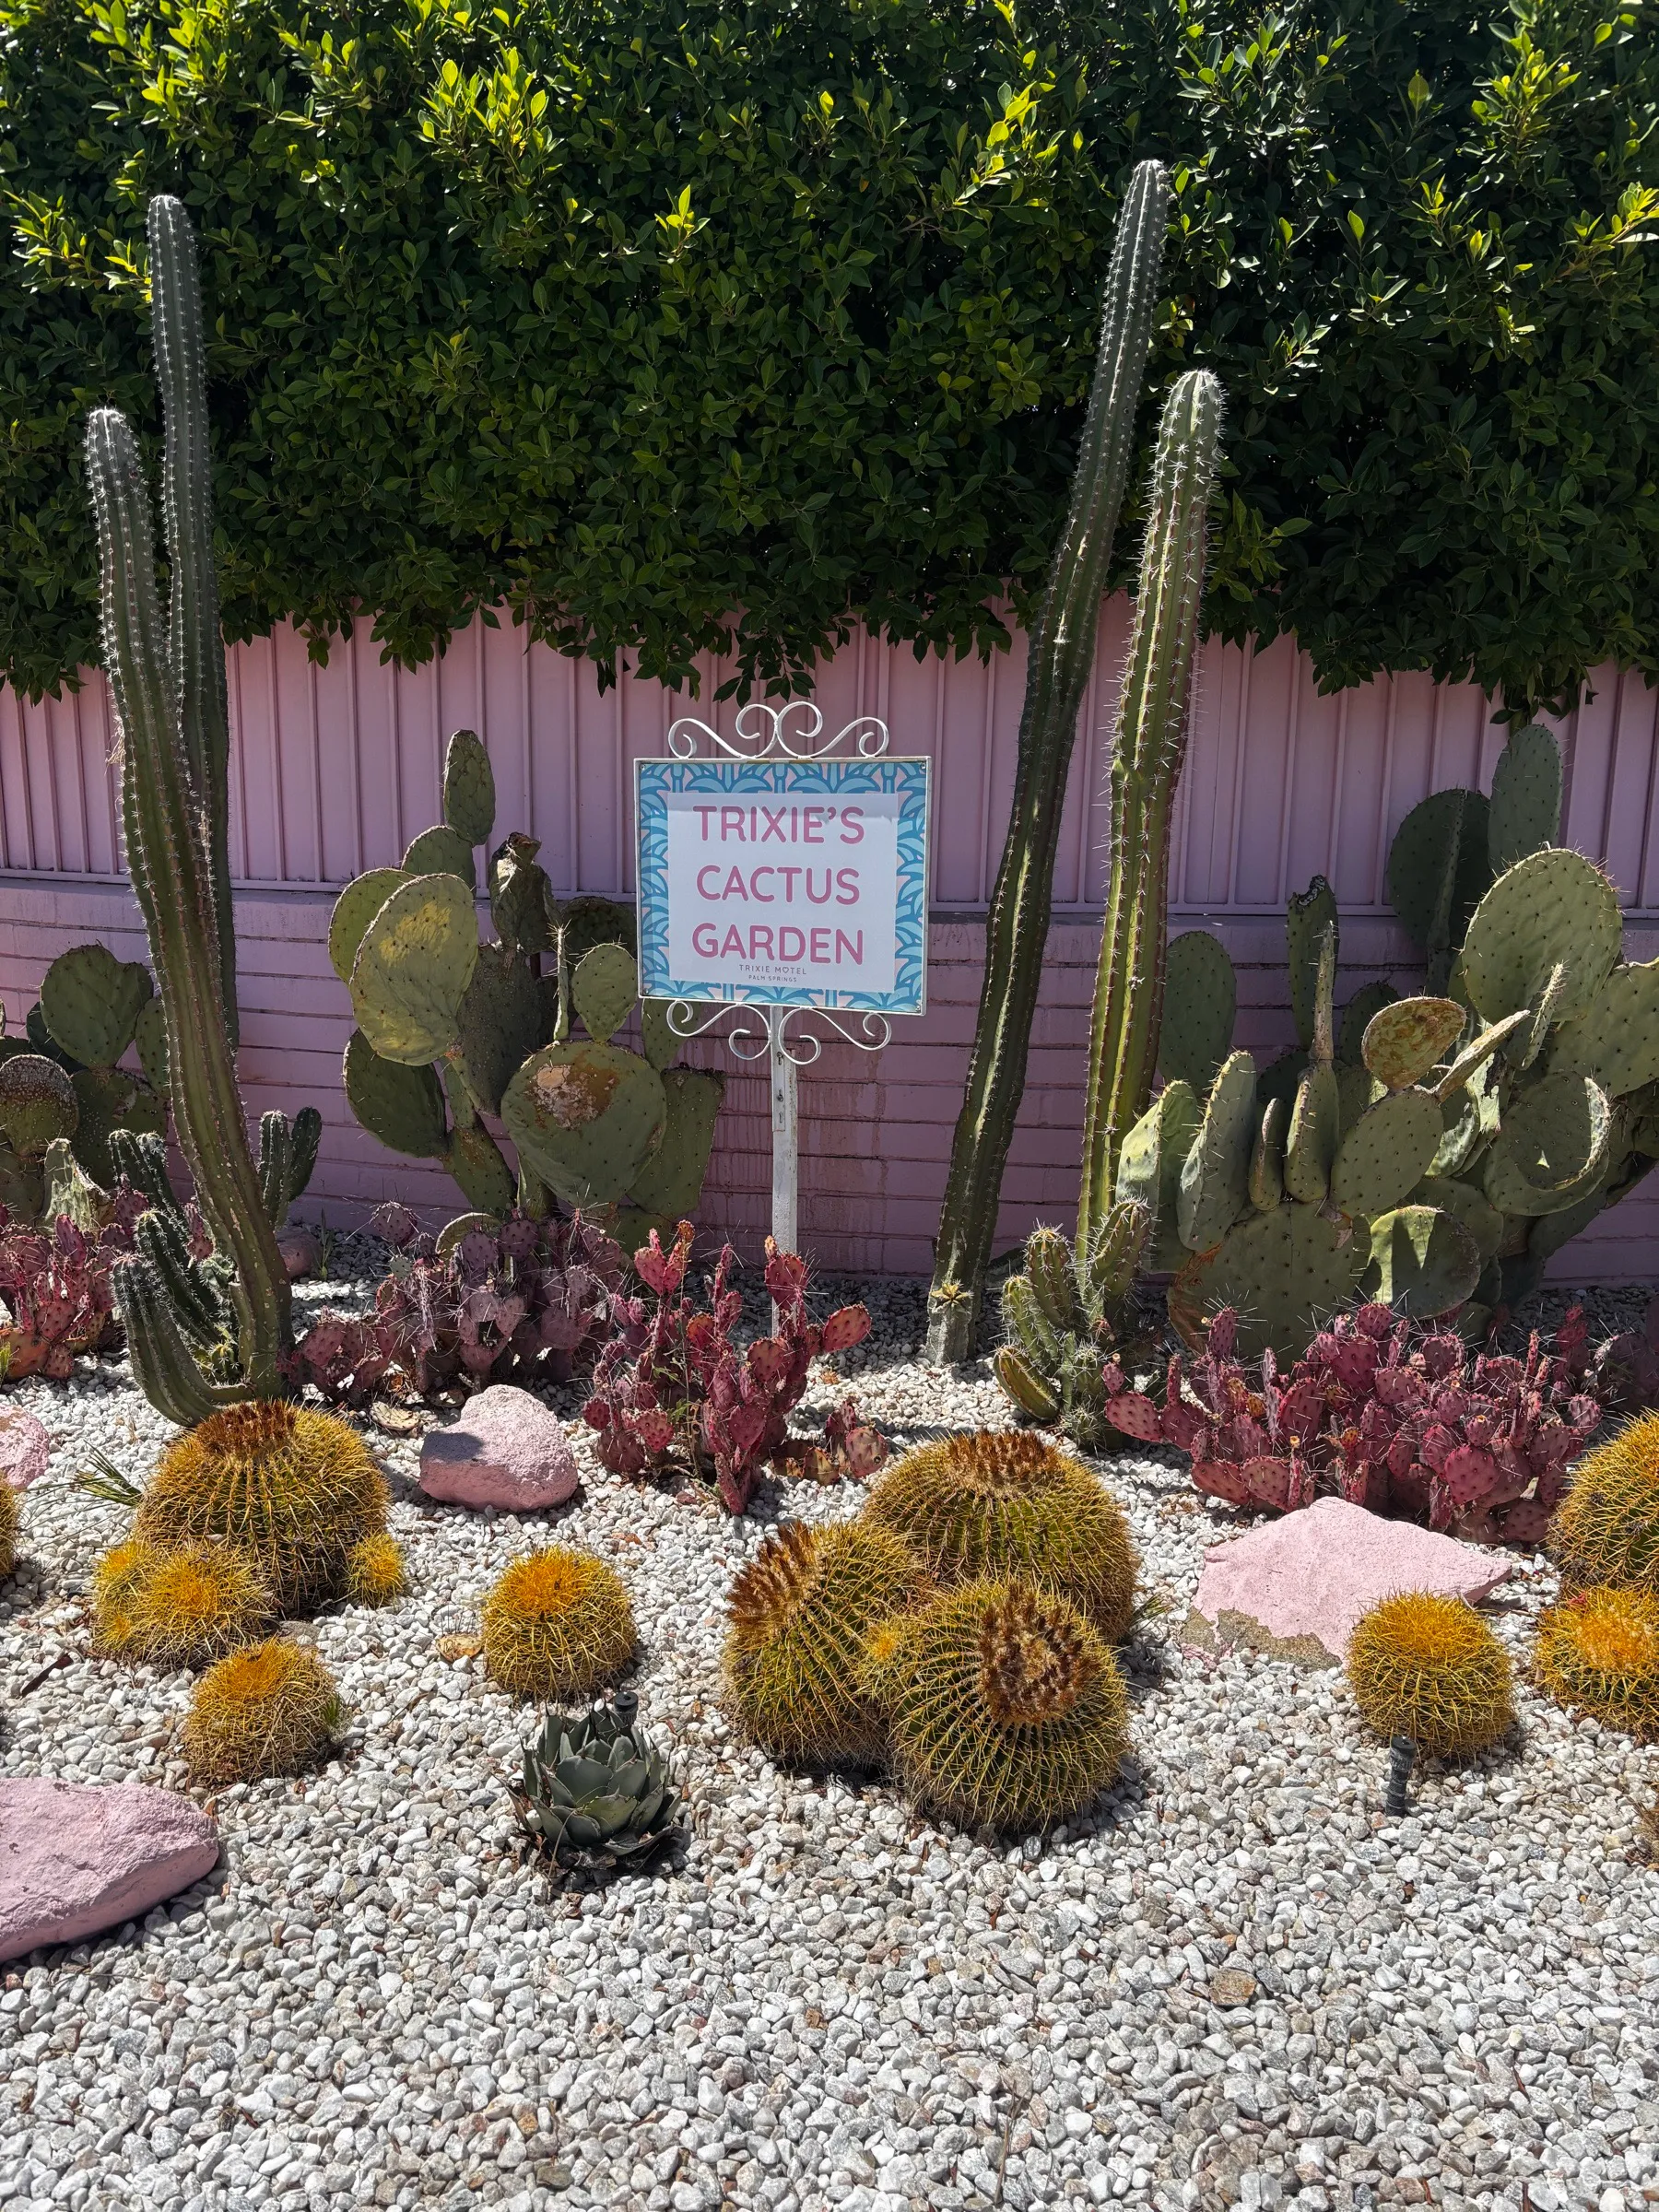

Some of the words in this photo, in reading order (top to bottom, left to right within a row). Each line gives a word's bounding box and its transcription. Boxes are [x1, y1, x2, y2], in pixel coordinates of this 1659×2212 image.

[692, 806, 865, 844] TRIXIE'S
[696, 865, 861, 905] CACTUS
[691, 923, 864, 965] GARDEN
[739, 964, 771, 973] TRIXIE
